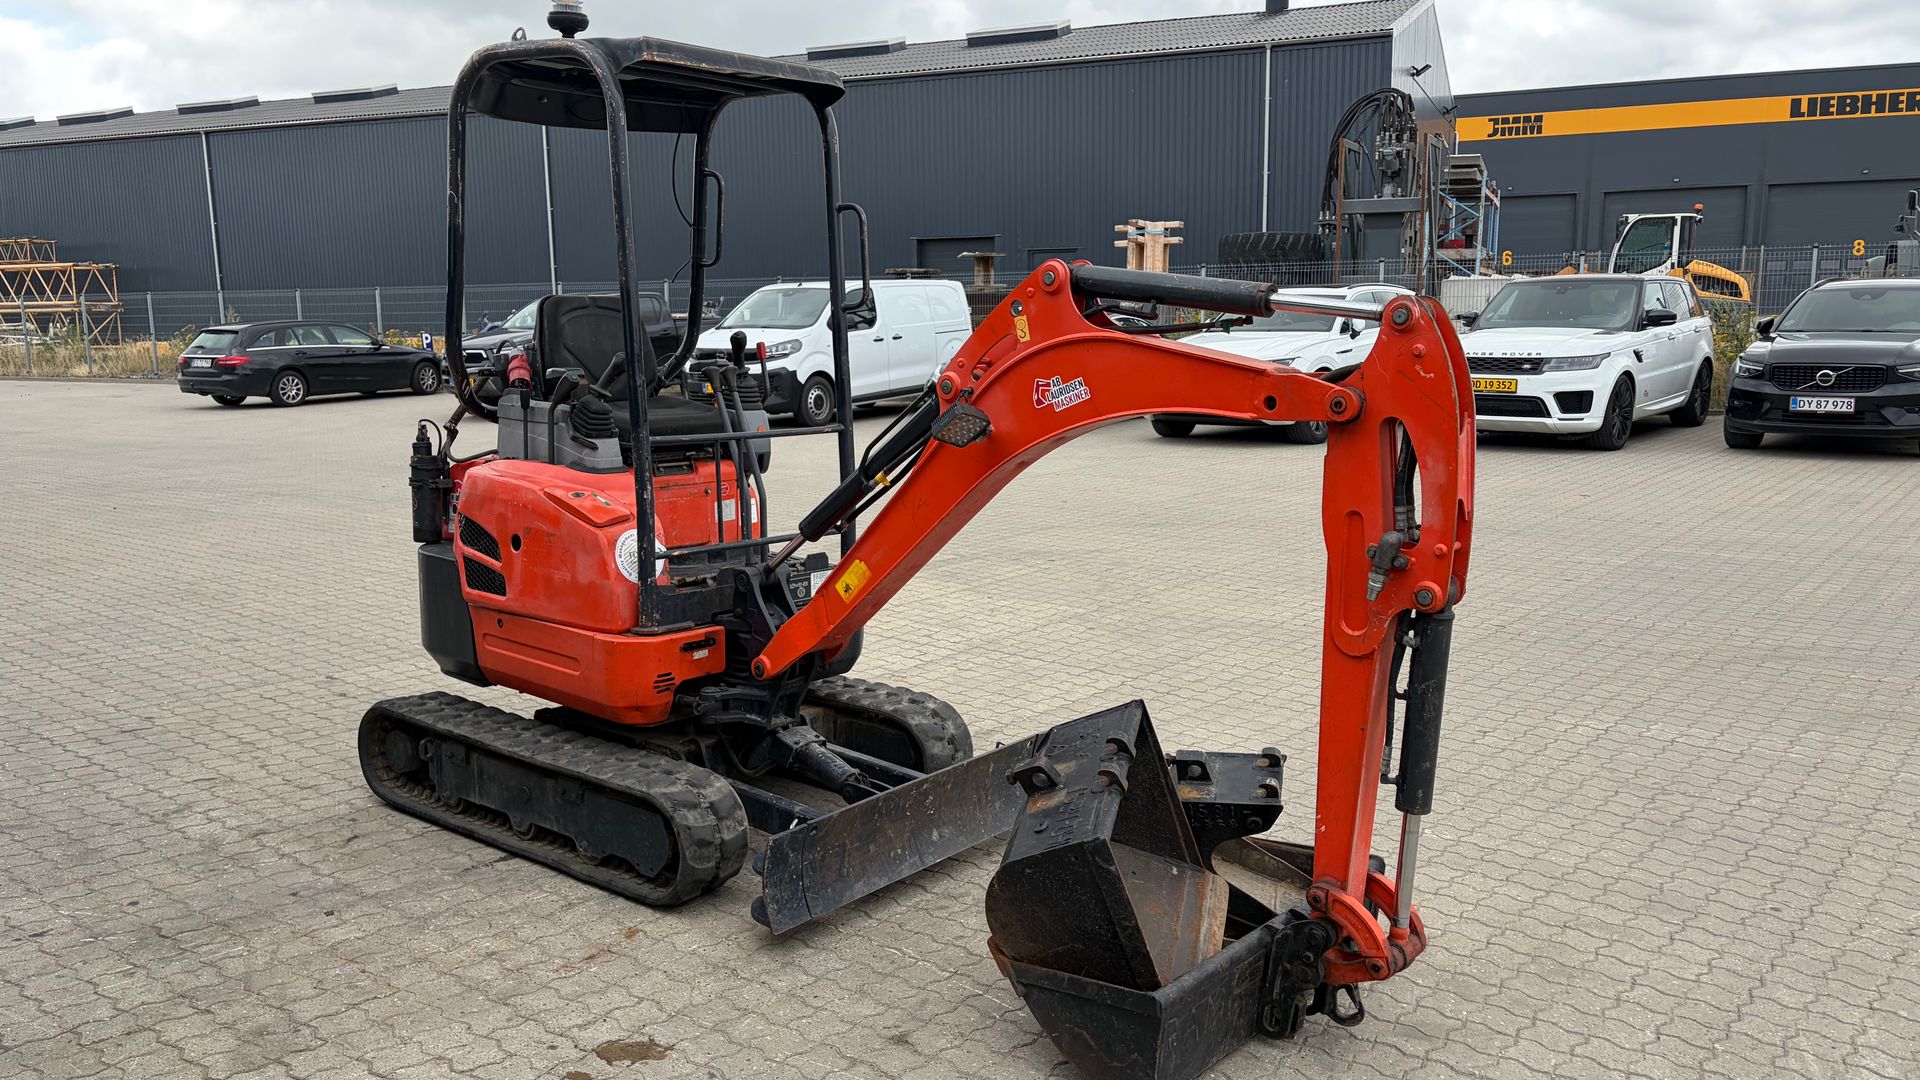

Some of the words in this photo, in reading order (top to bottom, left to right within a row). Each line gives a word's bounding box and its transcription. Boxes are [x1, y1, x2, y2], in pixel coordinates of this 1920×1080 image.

[1790, 91, 1920, 118] LIEBHER
[1488, 114, 1543, 138] JMM
[1852, 239, 1865, 257] 8
[1501, 250, 1513, 266] 6
[422, 333, 431, 348] P
[1046, 378, 1084, 402] LAURIDSEN
[1051, 377, 1061, 389] AB
[1484, 380, 1494, 389] 19
[1496, 380, 1512, 390] 352
[1054, 388, 1090, 410] MASKINER
[1798, 399, 1813, 409] DY
[1815, 399, 1829, 409] 87
[1831, 400, 1853, 410] 978
